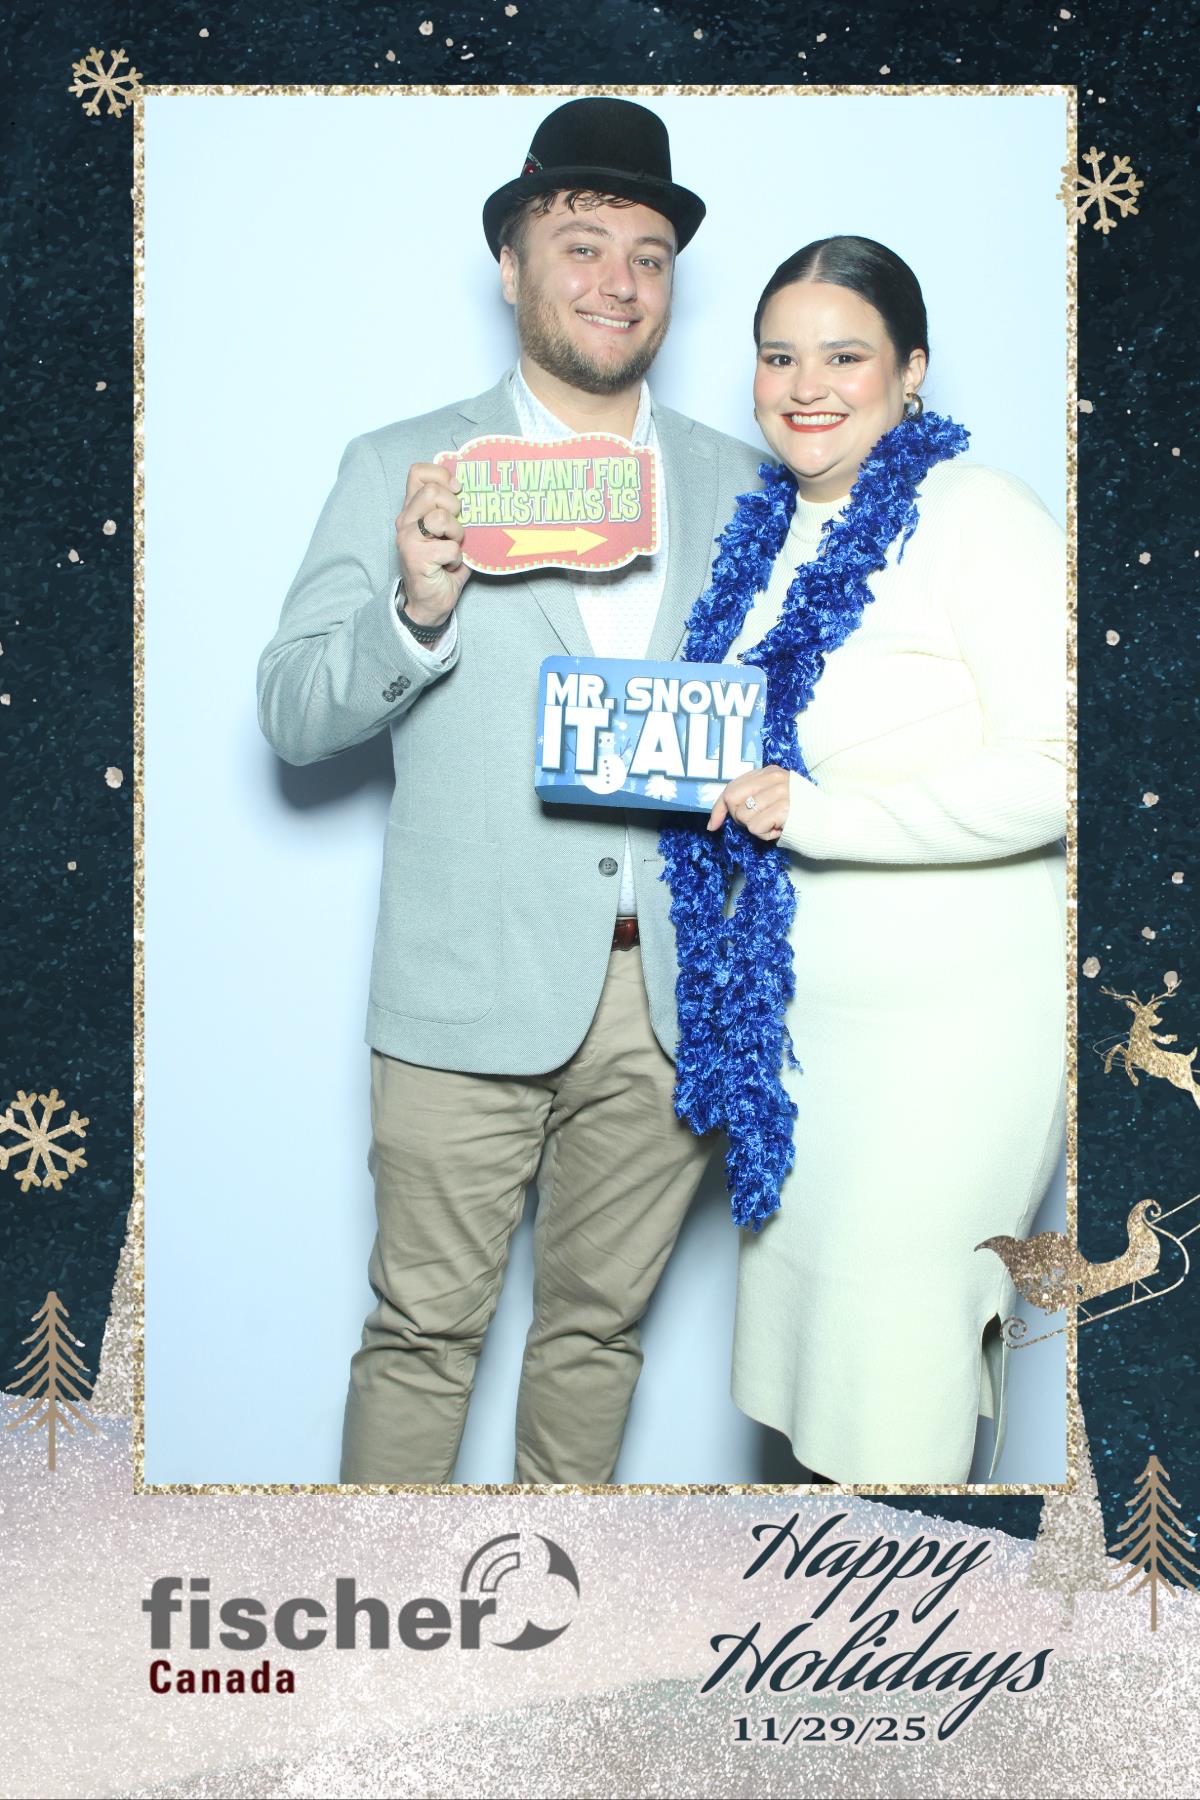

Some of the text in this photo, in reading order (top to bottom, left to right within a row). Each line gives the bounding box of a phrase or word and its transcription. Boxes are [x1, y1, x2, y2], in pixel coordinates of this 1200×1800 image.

[456, 457, 641, 493] ALL I WANT FOR
[457, 488, 642, 526] CHRISTMAS IS
[546, 672, 760, 718] MR. SNOW
[542, 705, 755, 782] IT ALL
